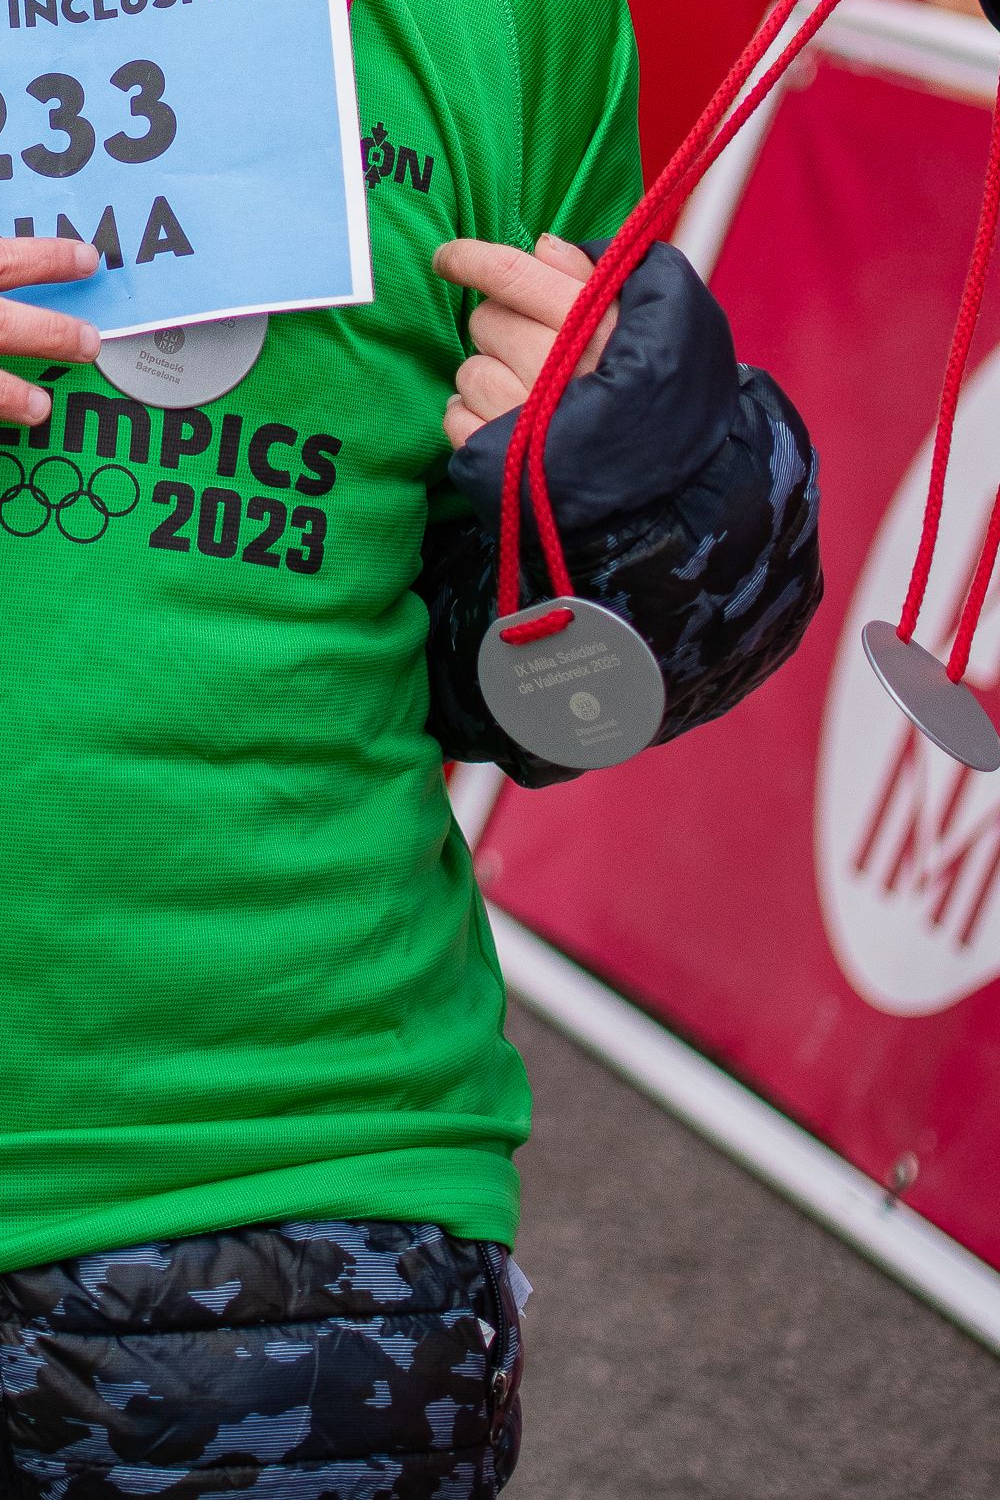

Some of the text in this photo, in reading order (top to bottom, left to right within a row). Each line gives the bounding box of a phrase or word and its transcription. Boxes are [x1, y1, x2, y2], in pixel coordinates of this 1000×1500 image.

[135, 360, 182, 385] Barcelona
[139, 349, 185, 374] Diputació
[148, 480, 328, 575] 2023
[527, 656, 558, 674] Milla
[518, 681, 535, 695] de
